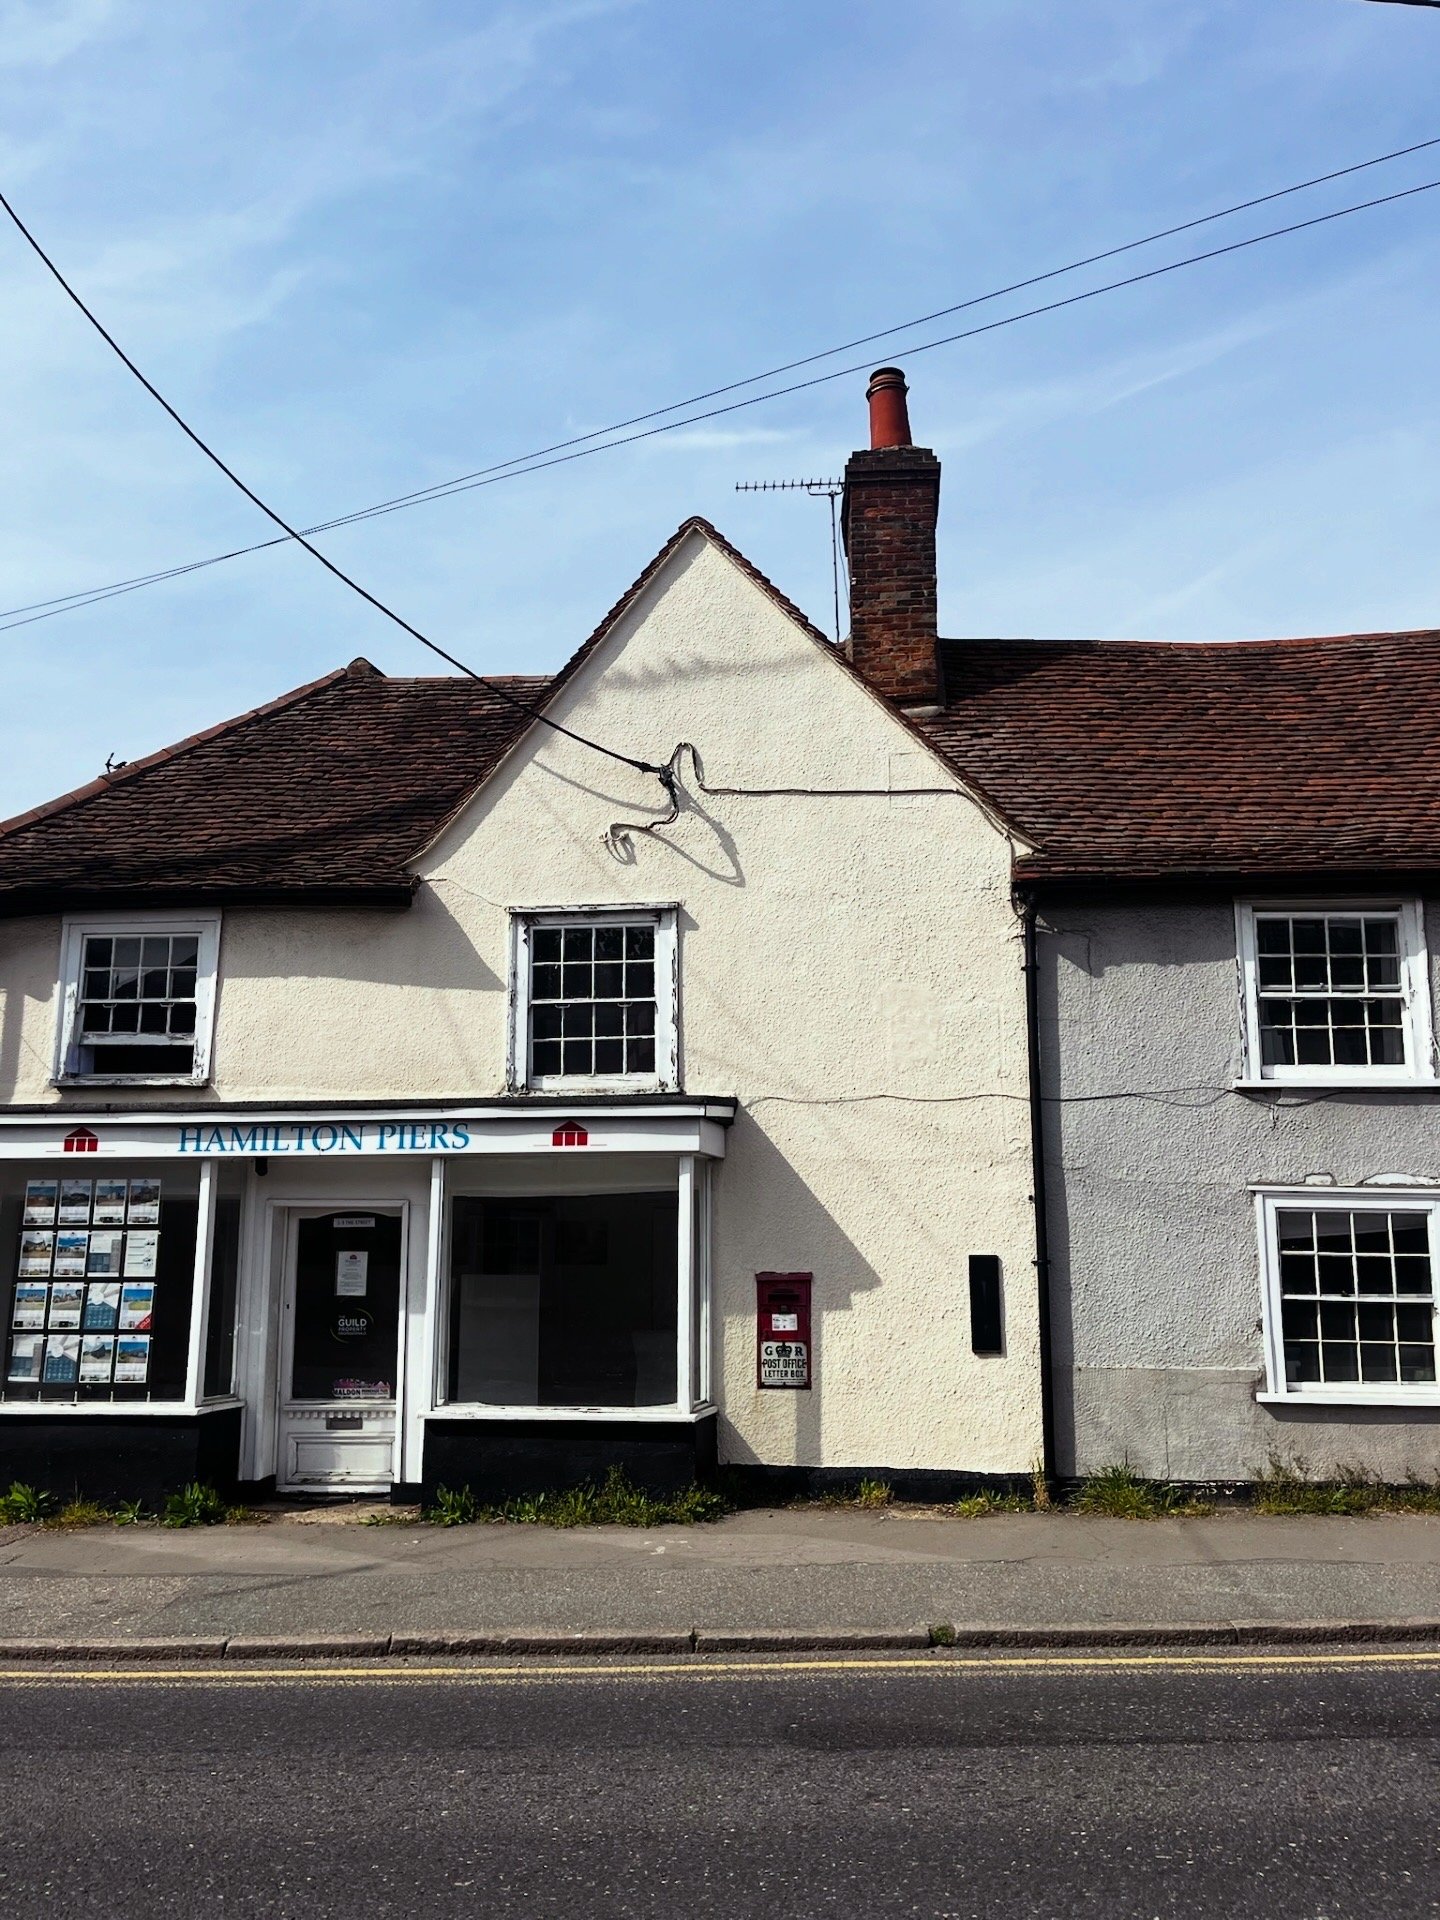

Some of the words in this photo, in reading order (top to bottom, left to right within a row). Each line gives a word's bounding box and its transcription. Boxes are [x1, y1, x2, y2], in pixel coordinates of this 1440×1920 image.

[177, 1124, 364, 1151] HAMILTON
[376, 1122, 470, 1150] PIERS
[338, 1318, 367, 1327] GUILD
[764, 1346, 773, 1356] G
[794, 1346, 804, 1356] R
[763, 1358, 781, 1368] POST
[782, 1358, 806, 1368] OFFICE
[764, 1369, 789, 1377] LETTER
